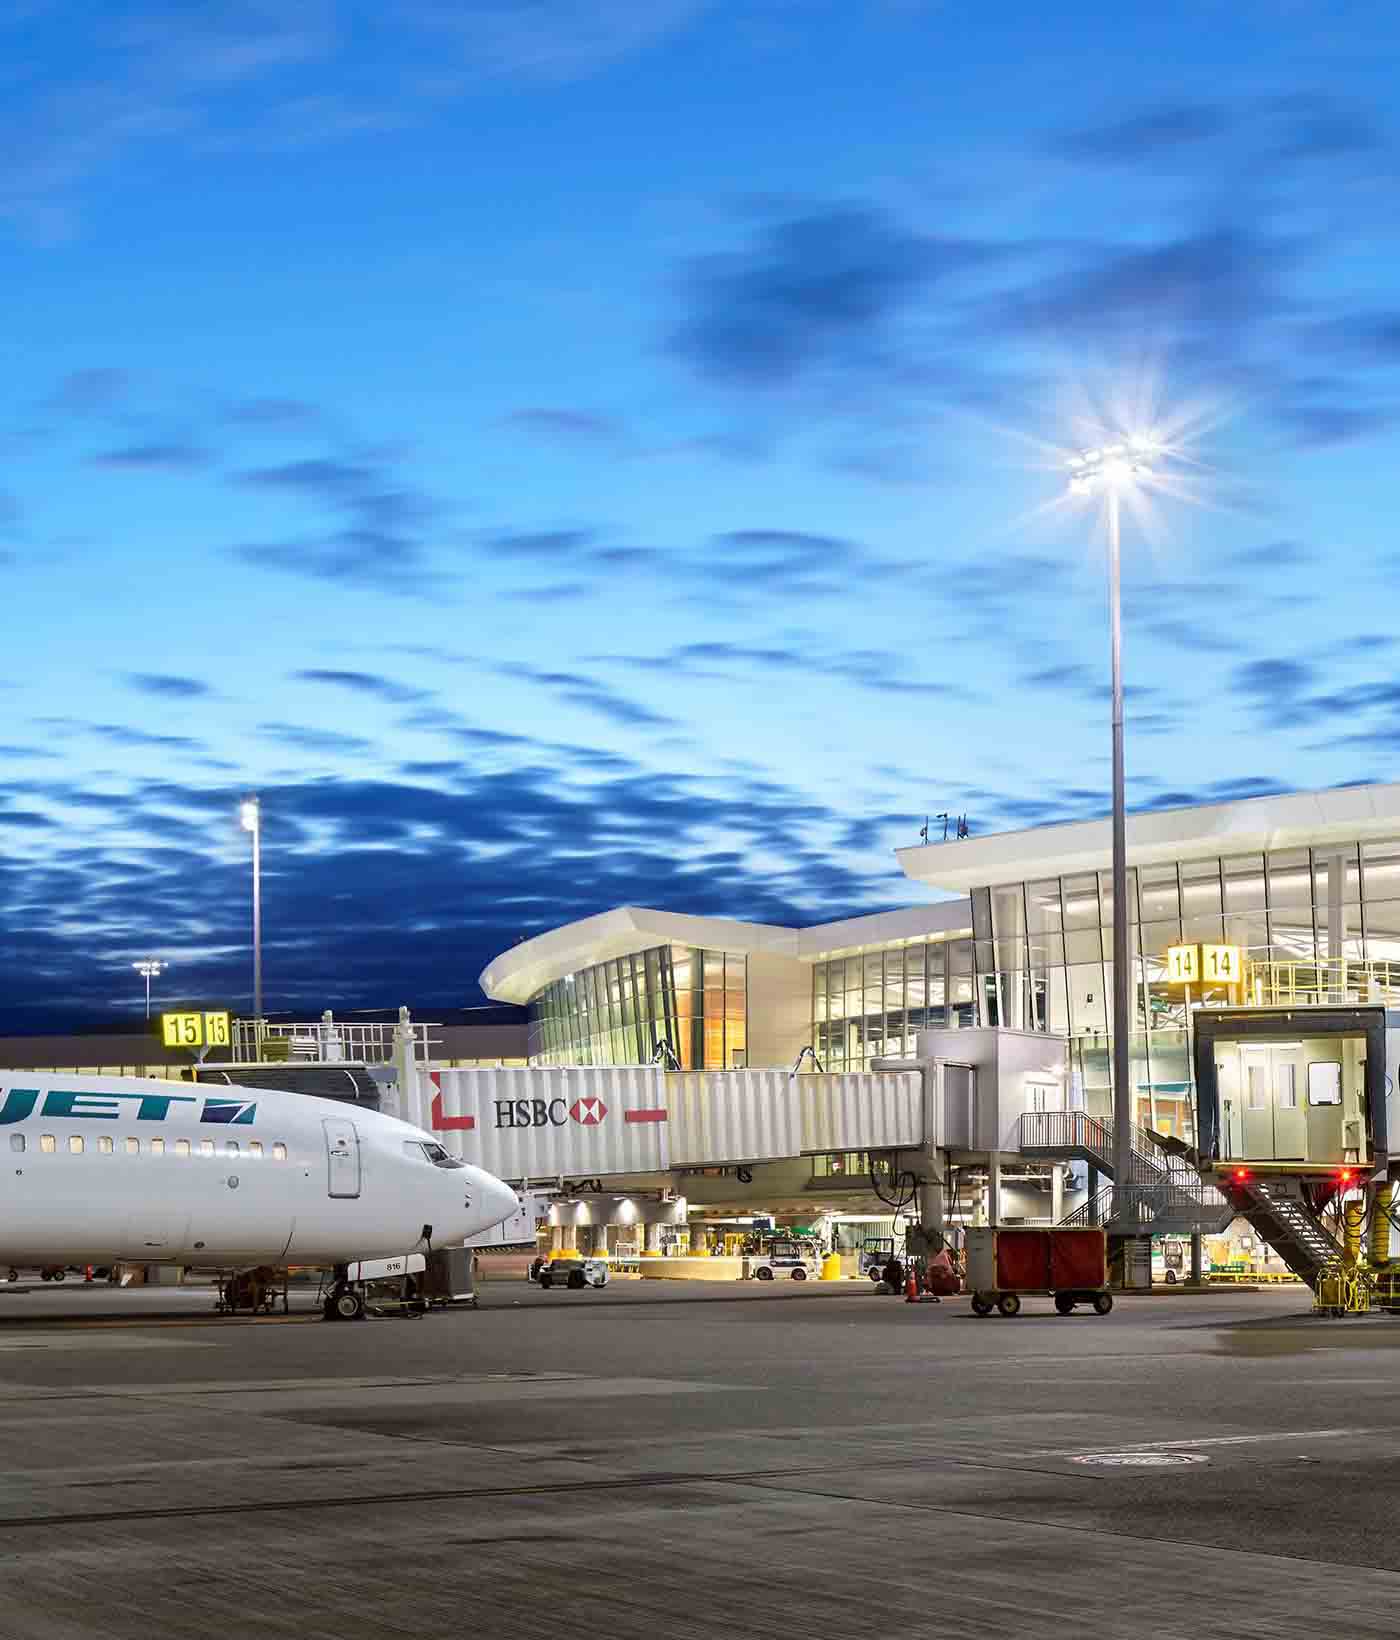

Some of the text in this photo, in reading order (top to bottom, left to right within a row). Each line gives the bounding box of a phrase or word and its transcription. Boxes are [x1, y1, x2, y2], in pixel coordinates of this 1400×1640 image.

[1175, 951, 1192, 976] 14
[1210, 951, 1231, 975] 14
[169, 1016, 197, 1043] 15
[209, 1016, 225, 1042] 15
[494, 1098, 568, 1129] HSBC
[386, 1263, 401, 1271] 816
